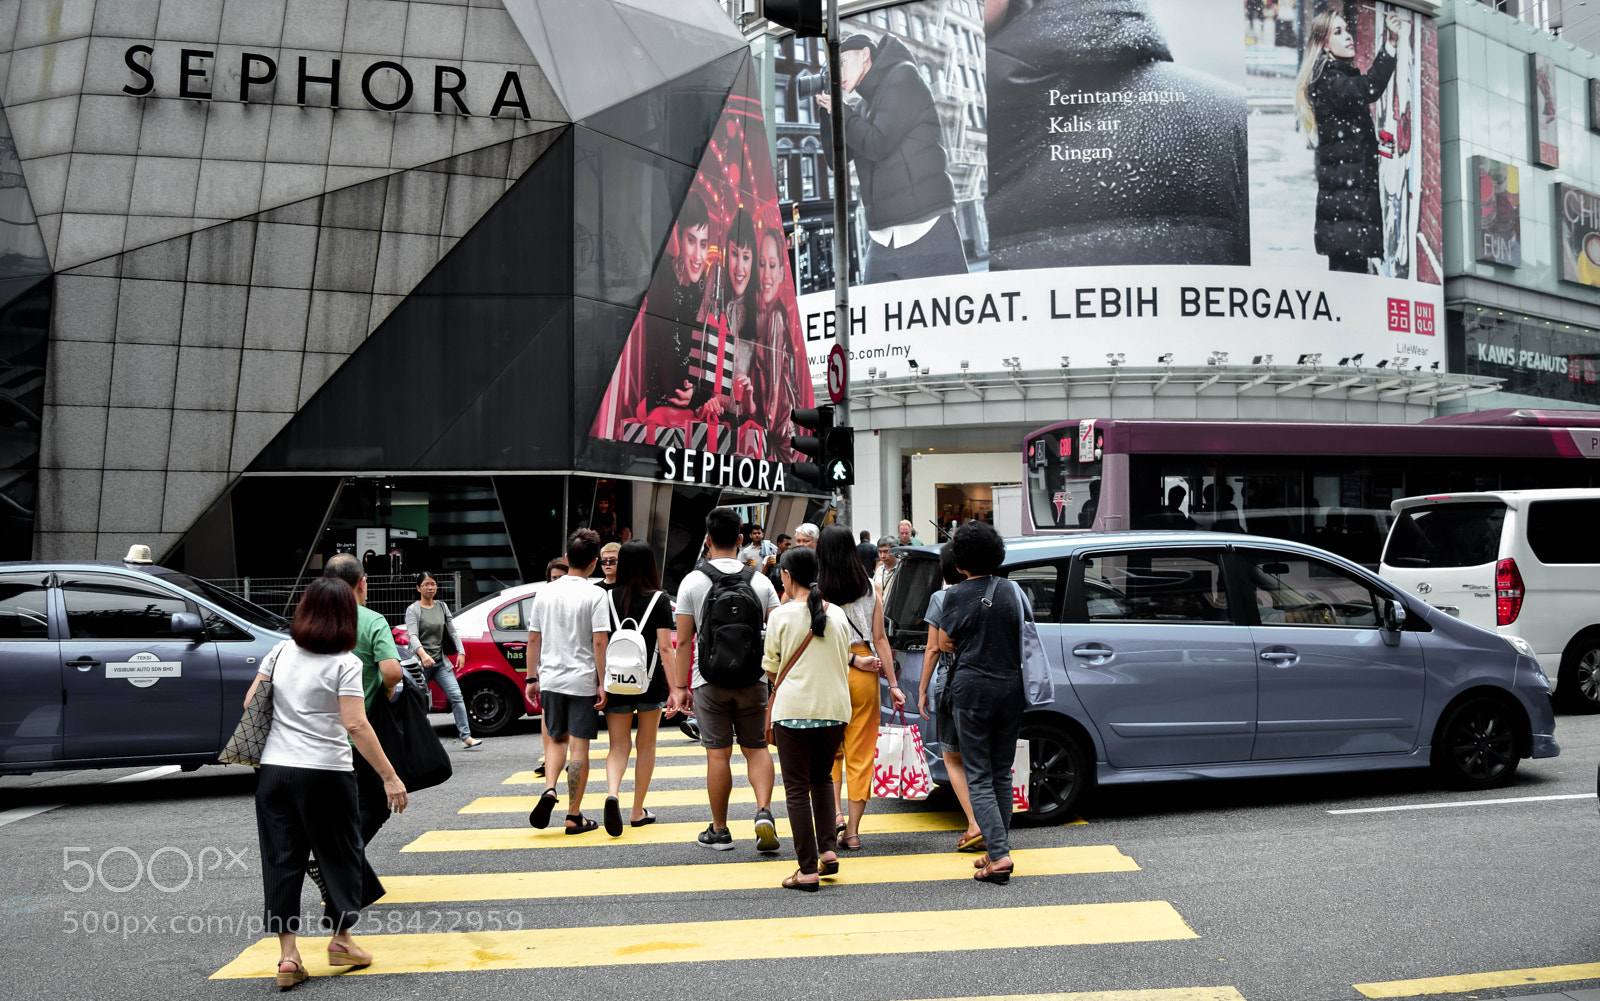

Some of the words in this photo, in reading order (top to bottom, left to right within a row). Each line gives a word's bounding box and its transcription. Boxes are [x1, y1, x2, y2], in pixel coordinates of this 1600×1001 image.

[122, 45, 531, 120] SEPHORA
[1049, 90, 1133, 106] Perintang
[1139, 90, 1187, 106] angin
[1049, 116, 1092, 133] Kalis
[1097, 116, 1121, 131] air
[1050, 145, 1113, 163] Ringan
[1564, 190, 1600, 230] CHI
[1484, 234, 1512, 261] FUN
[807, 305, 866, 342] EBH
[885, 291, 1028, 332] HANGAT.
[1050, 287, 1158, 320] LEBIH
[1180, 287, 1341, 322] BERGAYA.
[1416, 306, 1431, 319] UNI
[1417, 319, 1433, 333] QLO
[1396, 343, 1429, 356] LifeWear
[1478, 343, 1516, 366] KAWS
[1519, 350, 1568, 374] PEANUTS
[1591, 437, 1600, 450] P
[664, 446, 785, 492] SEPHORA
[507, 650, 523, 659] has
[611, 673, 637, 684] FILA
